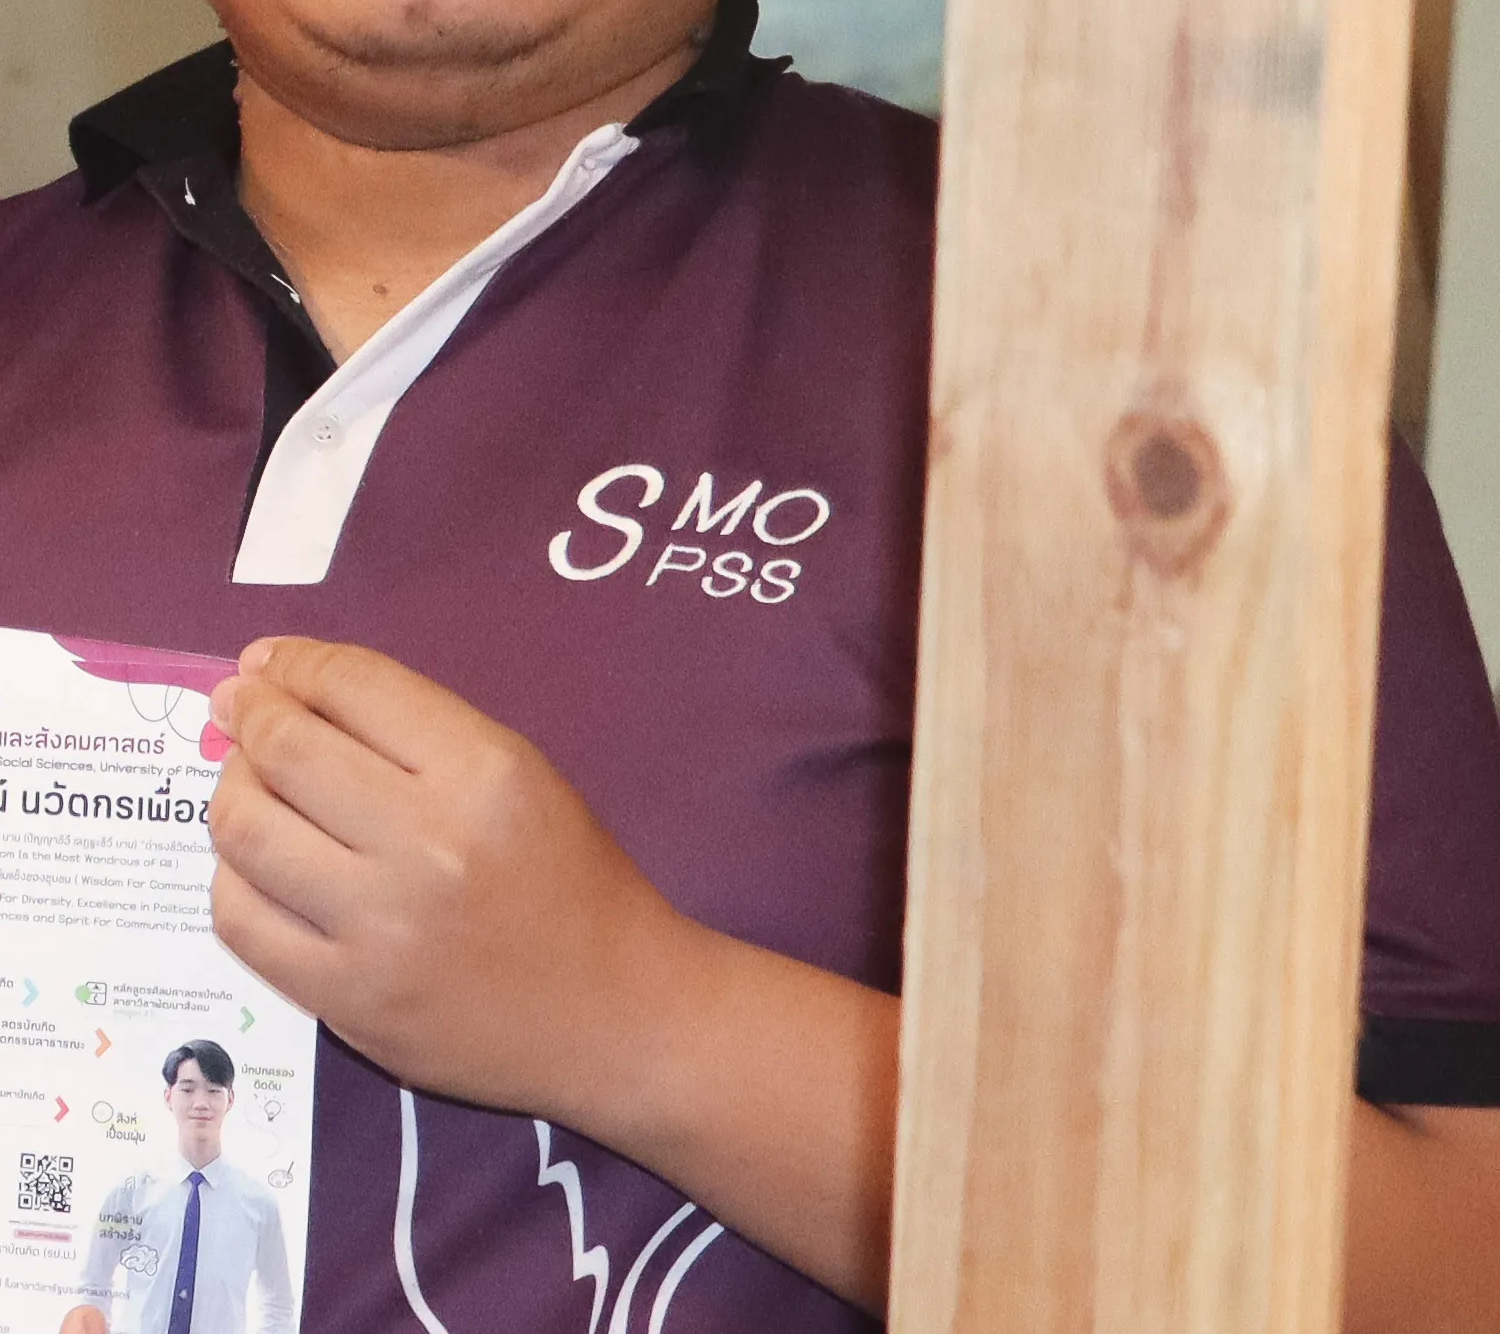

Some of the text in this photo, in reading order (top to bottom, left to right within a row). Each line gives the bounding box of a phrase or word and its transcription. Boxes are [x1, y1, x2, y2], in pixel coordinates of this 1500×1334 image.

[645, 542, 802, 604] PSS
[36, 758, 96, 772] Sciences,
[100, 761, 163, 777] University
[32, 851, 50, 860] the
[54, 853, 80, 863] Most
[84, 854, 140, 867] Wondrous
[82, 875, 123, 887] Wisdom
[78, 898, 136, 910] Excellence
[33, 914, 55, 923] and
[116, 918, 177, 933] Community
